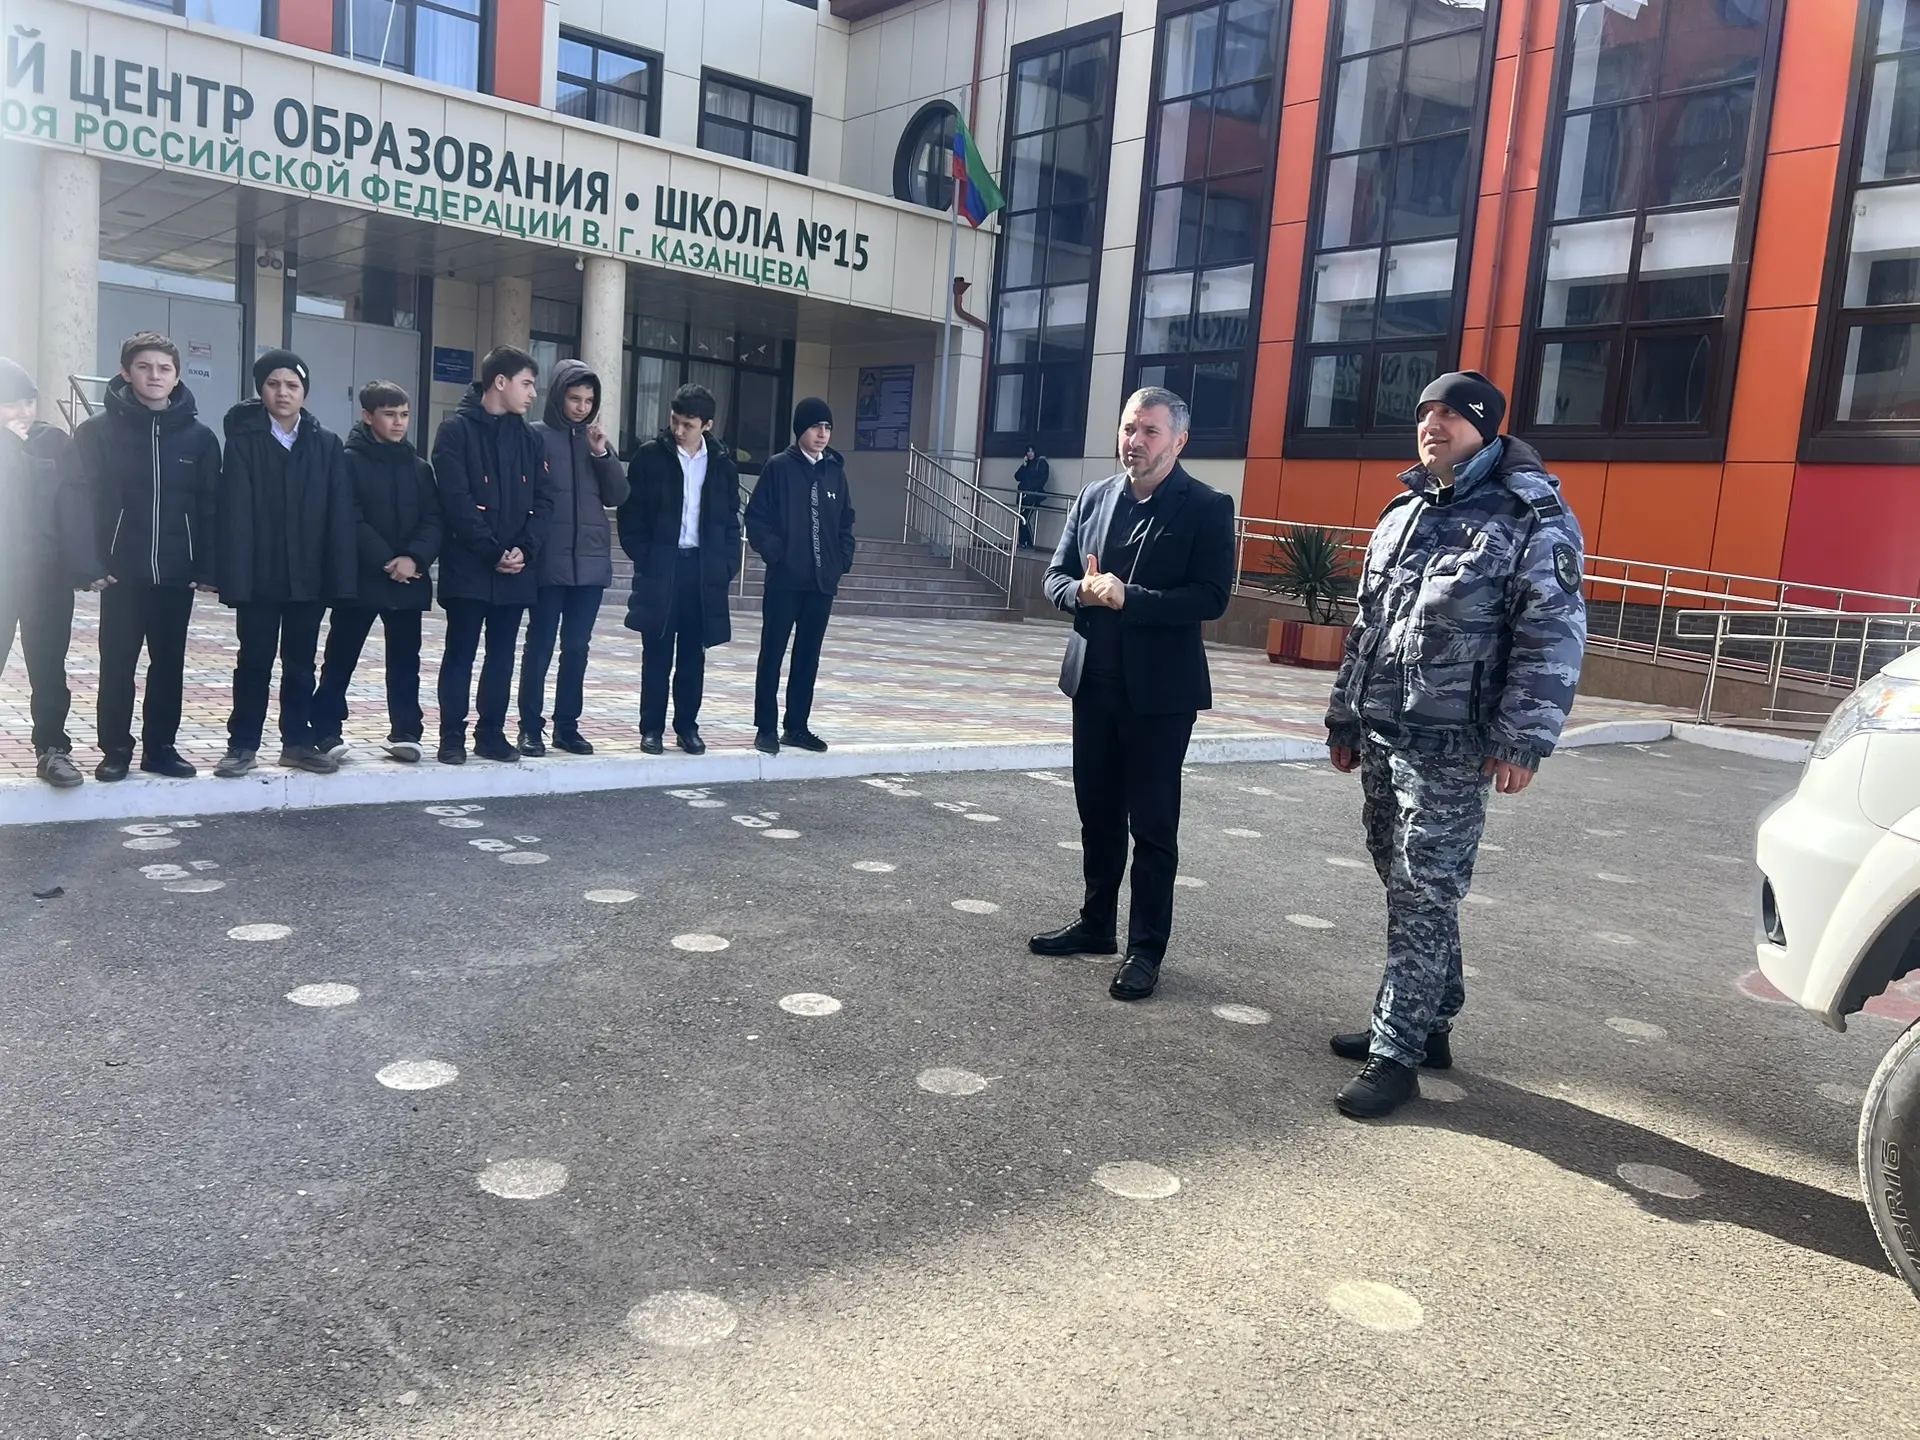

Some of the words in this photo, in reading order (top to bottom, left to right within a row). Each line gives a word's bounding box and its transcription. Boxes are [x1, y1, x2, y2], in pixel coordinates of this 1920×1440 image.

[70, 49, 254, 134] ЦЕНТР
[273, 98, 609, 214] ОБРАЗОВАНИЯ
[655, 185, 784, 252] ШКОЛА
[796, 217, 869, 271] №15
[75, 112, 349, 197] РОССИЙСКОЙ
[361, 174, 571, 241] ФЕДЕРАЦИИ
[582, 220, 608, 249] В.
[619, 227, 641, 256] Г.
[651, 233, 810, 291] КАЗАНЦЕВА
